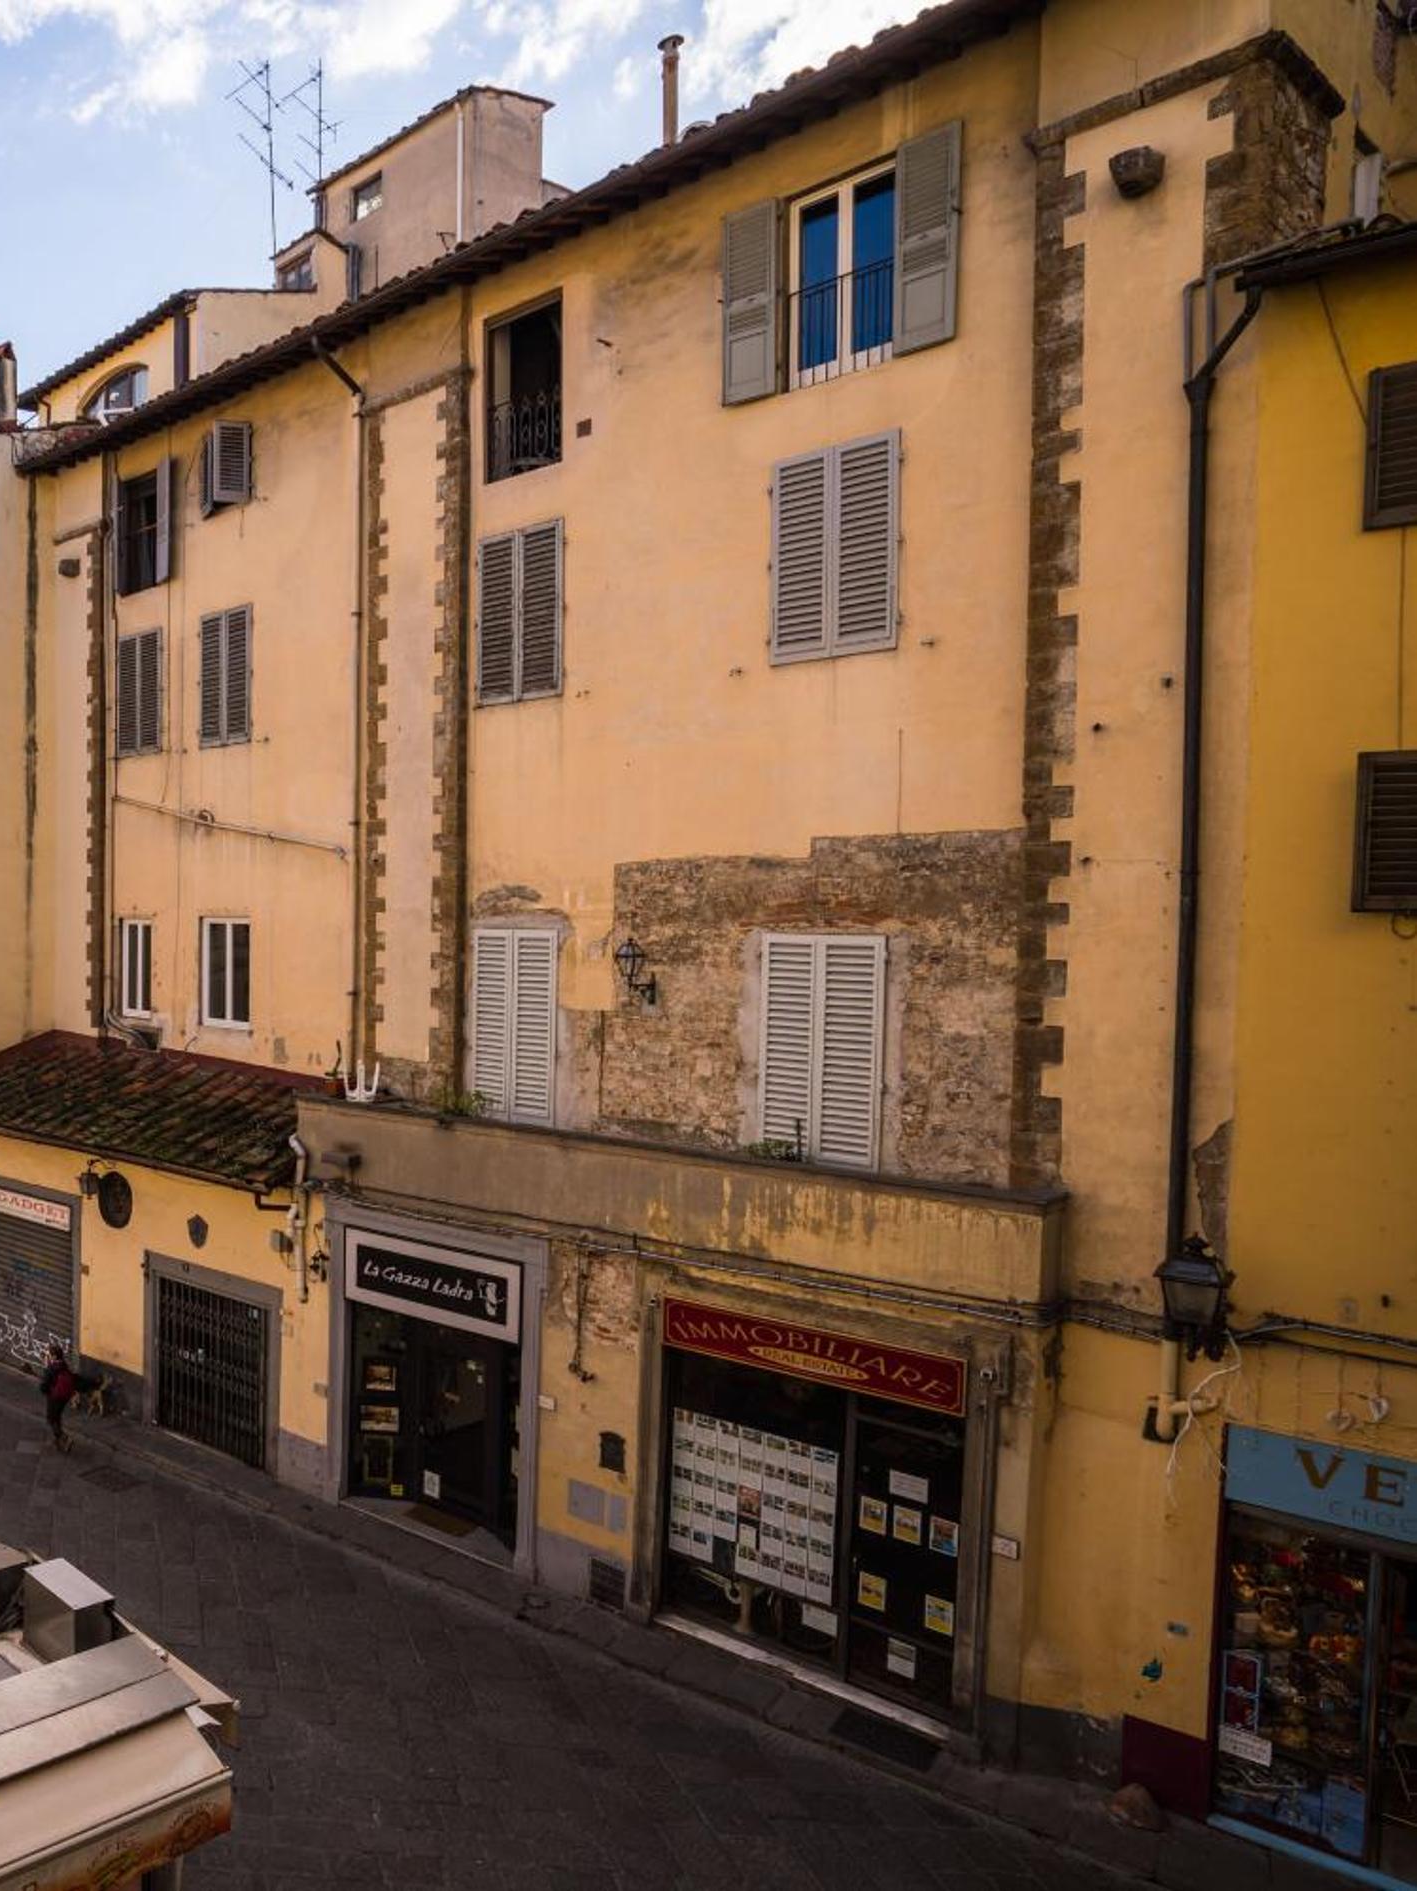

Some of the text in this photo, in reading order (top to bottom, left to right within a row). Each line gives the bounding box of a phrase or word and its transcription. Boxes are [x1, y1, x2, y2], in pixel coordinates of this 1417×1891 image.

[363, 1260, 474, 1302] La Gazza Ladra
[673, 1313, 954, 1399] IMMOBILIARE
